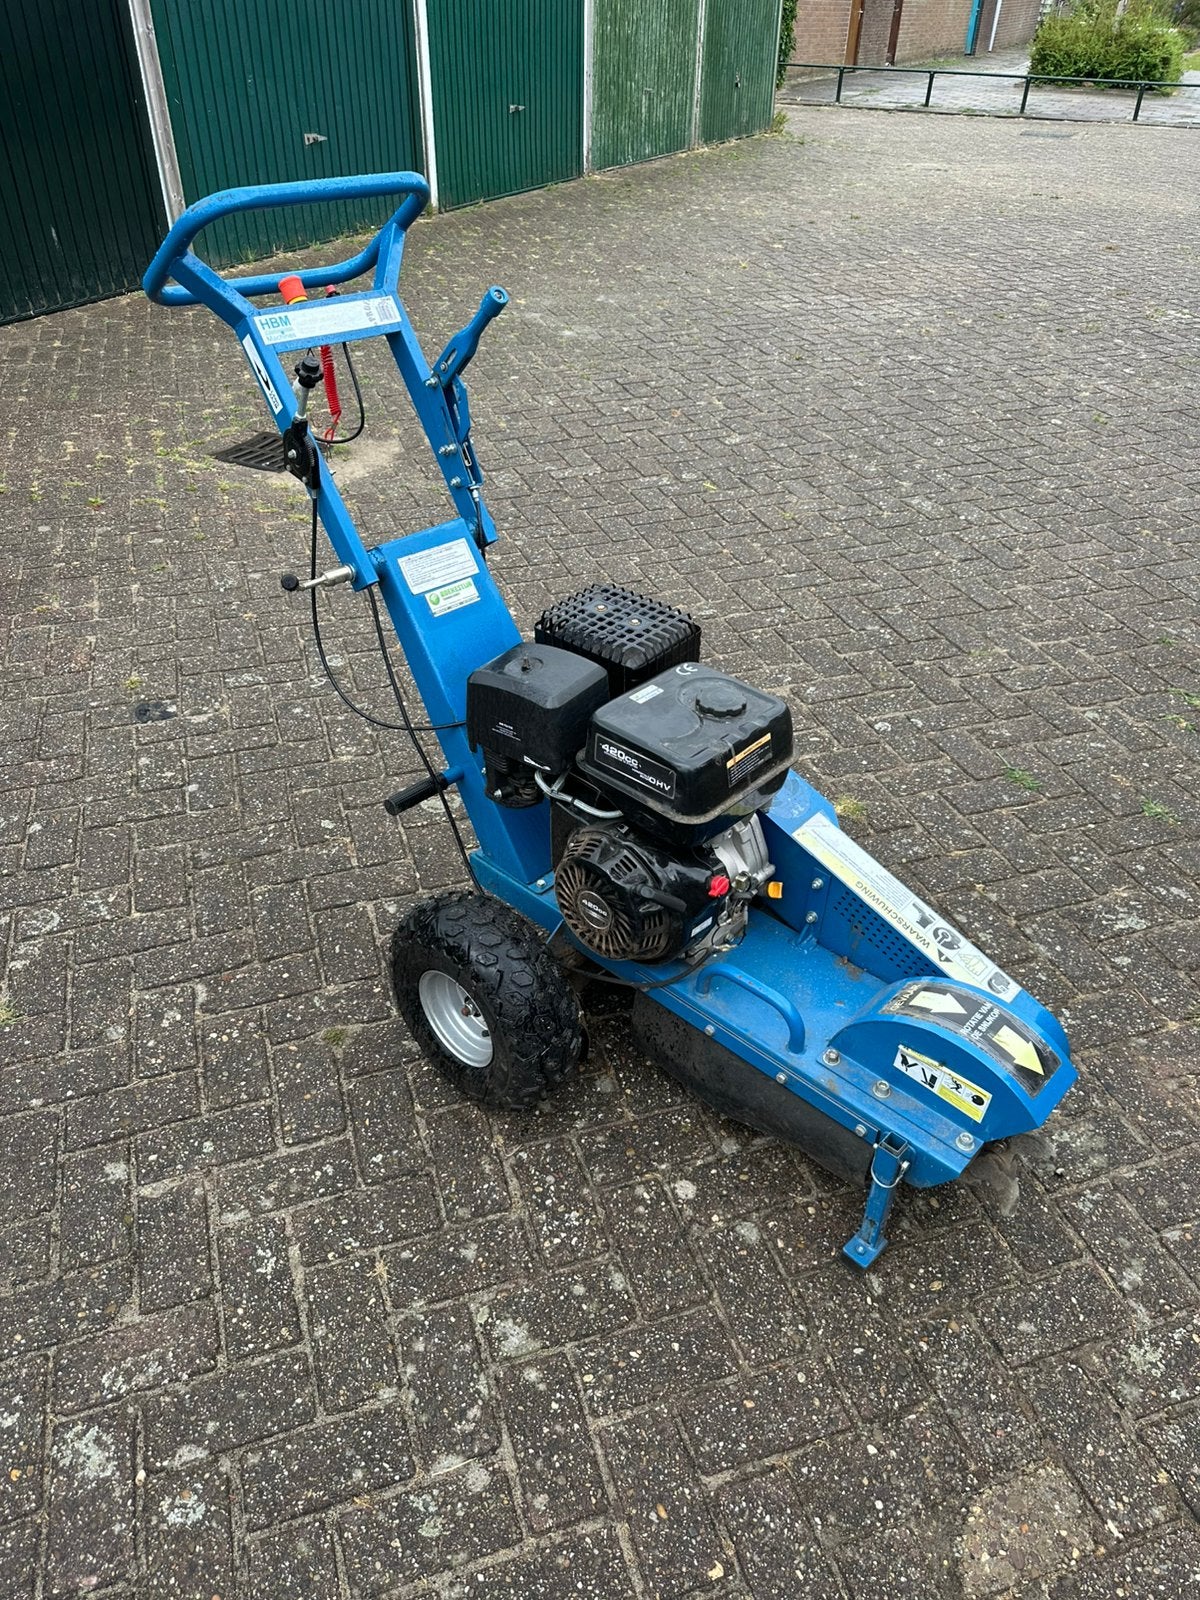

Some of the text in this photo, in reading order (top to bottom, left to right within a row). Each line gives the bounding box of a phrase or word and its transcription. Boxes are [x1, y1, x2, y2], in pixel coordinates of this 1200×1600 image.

[259, 315, 291, 330] HBM
[854, 880, 931, 950] WAARSCHUWING
[960, 1009, 985, 1034] ROTATIE
[971, 1028, 983, 1040] DE
